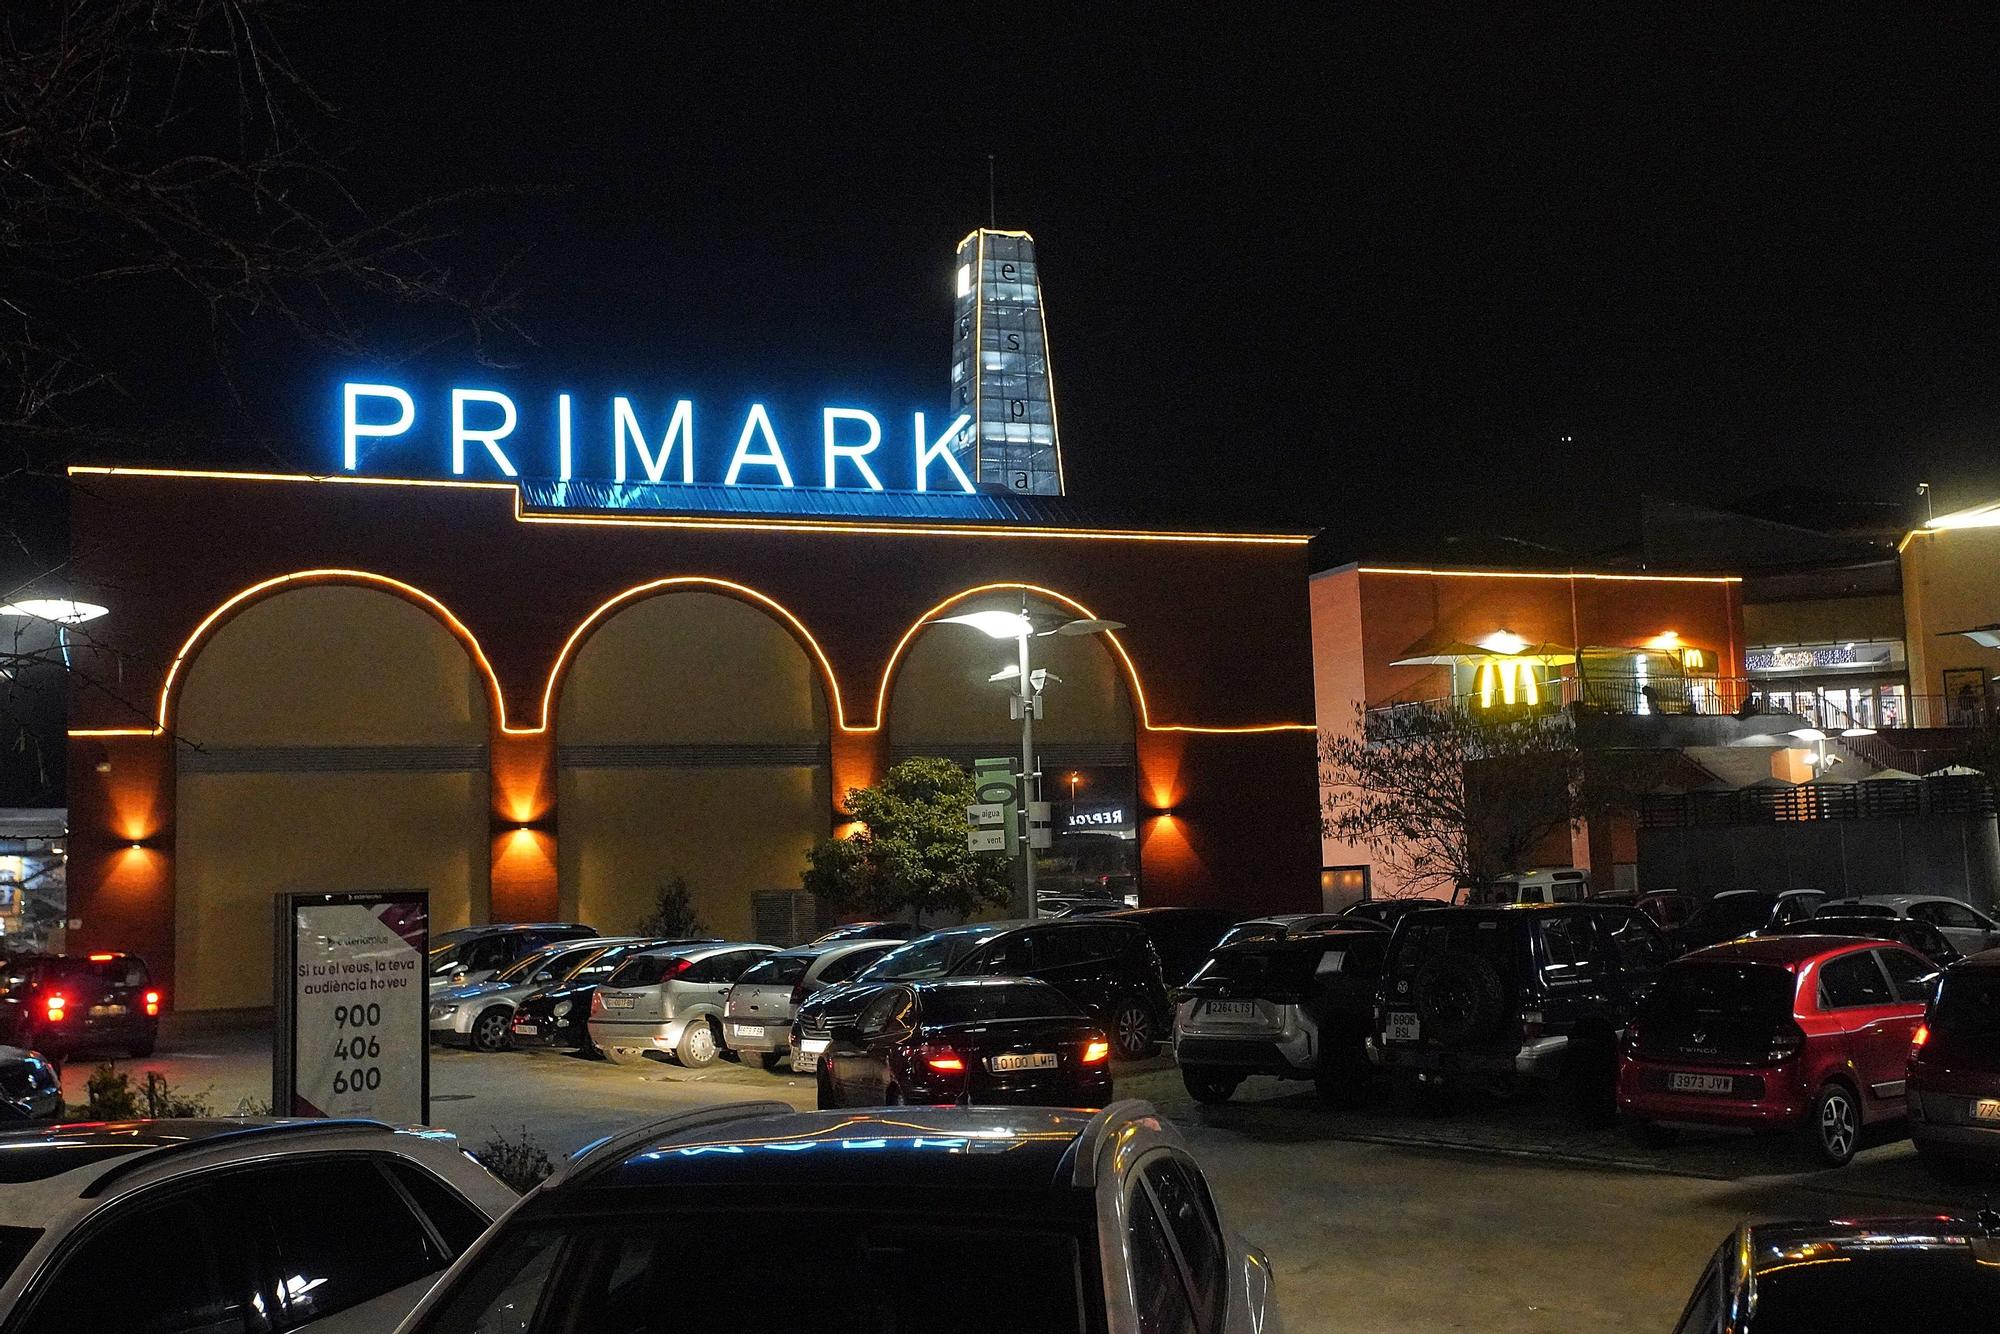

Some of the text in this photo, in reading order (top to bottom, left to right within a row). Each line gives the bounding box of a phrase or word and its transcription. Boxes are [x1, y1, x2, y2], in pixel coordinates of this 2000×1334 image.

[342, 382, 978, 494] PRIMARK
[986, 836, 1001, 844] vent
[313, 964, 326, 975] tu
[329, 963, 339, 974] el
[375, 960, 386, 971] la
[389, 960, 415, 971] teva
[304, 978, 407, 994] audiència ho veu
[335, 1003, 381, 1029] 900
[334, 1035, 380, 1061] 406
[1000, 1056, 1028, 1069] 0100
[333, 1068, 381, 1095] 600
[1676, 1075, 1704, 1088] 3973
